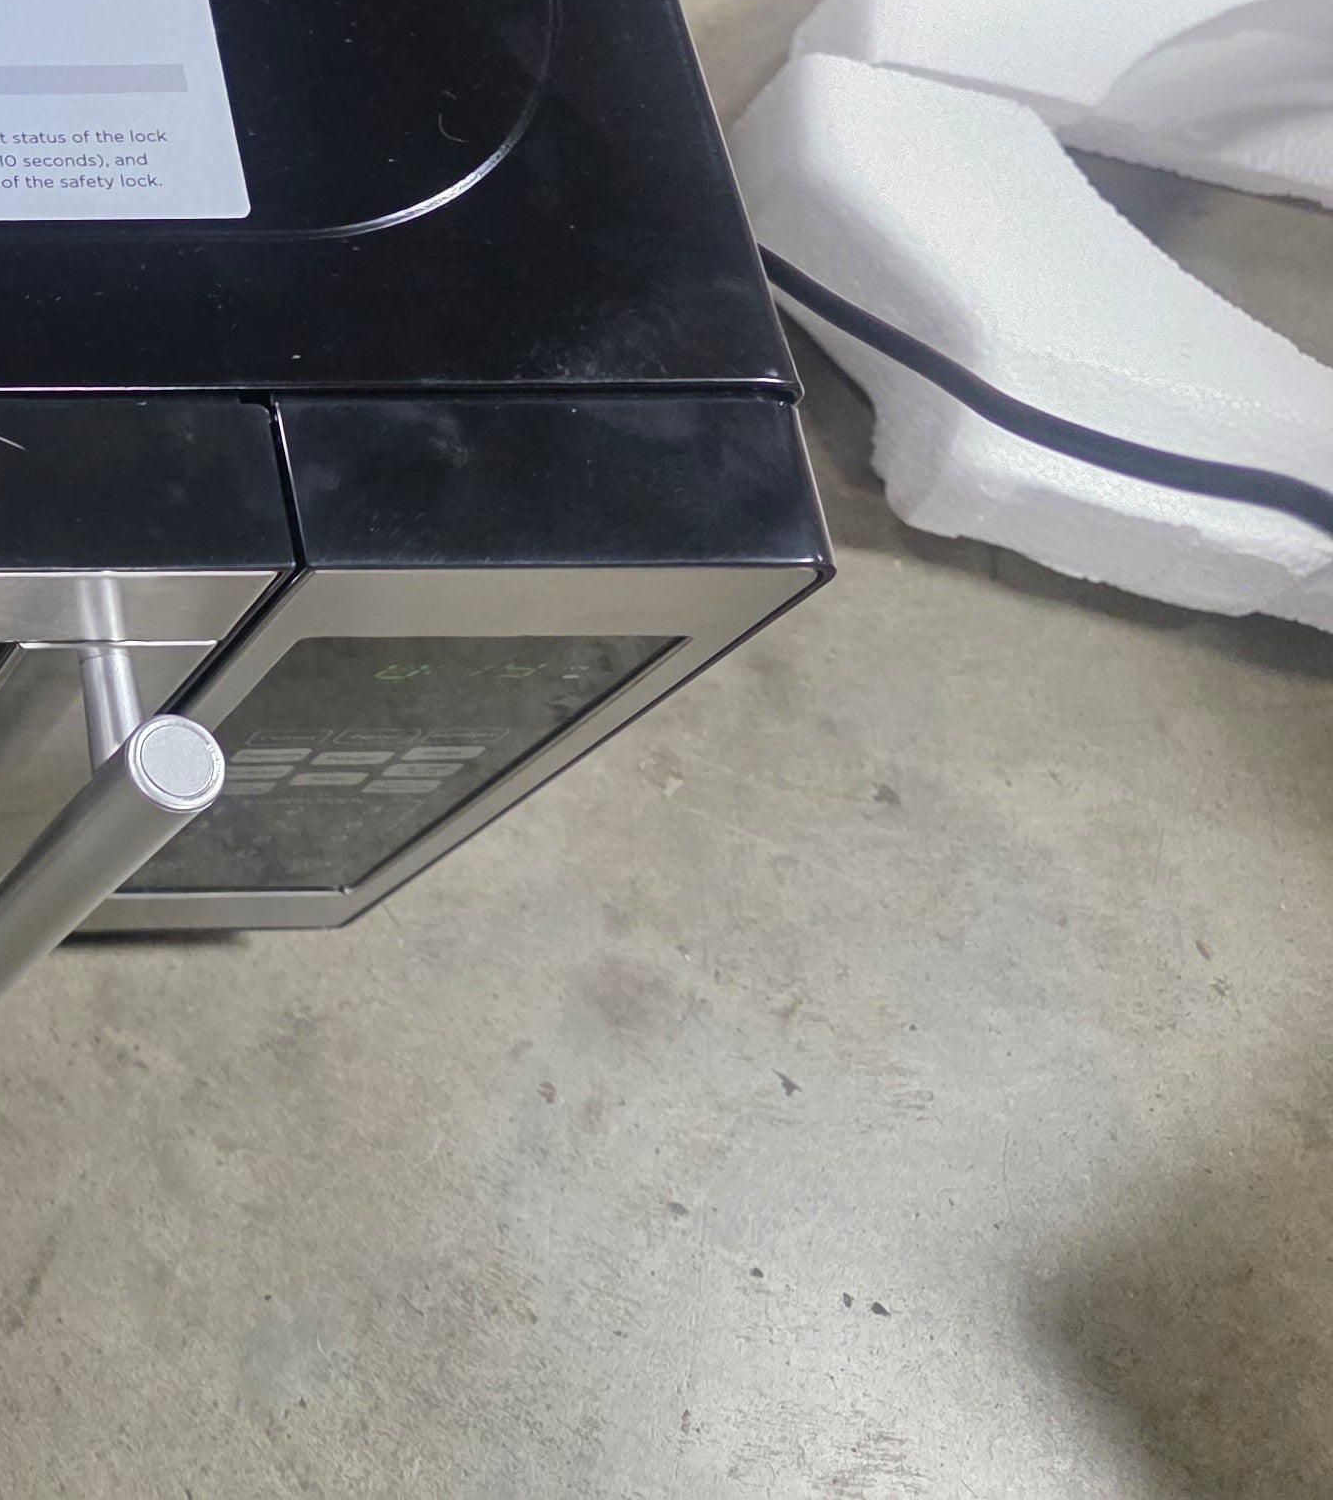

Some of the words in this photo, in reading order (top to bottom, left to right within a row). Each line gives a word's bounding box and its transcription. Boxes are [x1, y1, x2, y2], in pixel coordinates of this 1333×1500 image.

[11, 131, 67, 144] status
[70, 129, 90, 144] of
[94, 129, 124, 143] the
[128, 128, 168, 143] lock
[21, 153, 109, 169] seconds),
[113, 151, 148, 166] and
[0, 174, 20, 189] of
[24, 174, 54, 189] the
[59, 173, 114, 191] safety
[119, 172, 163, 188] lock.
